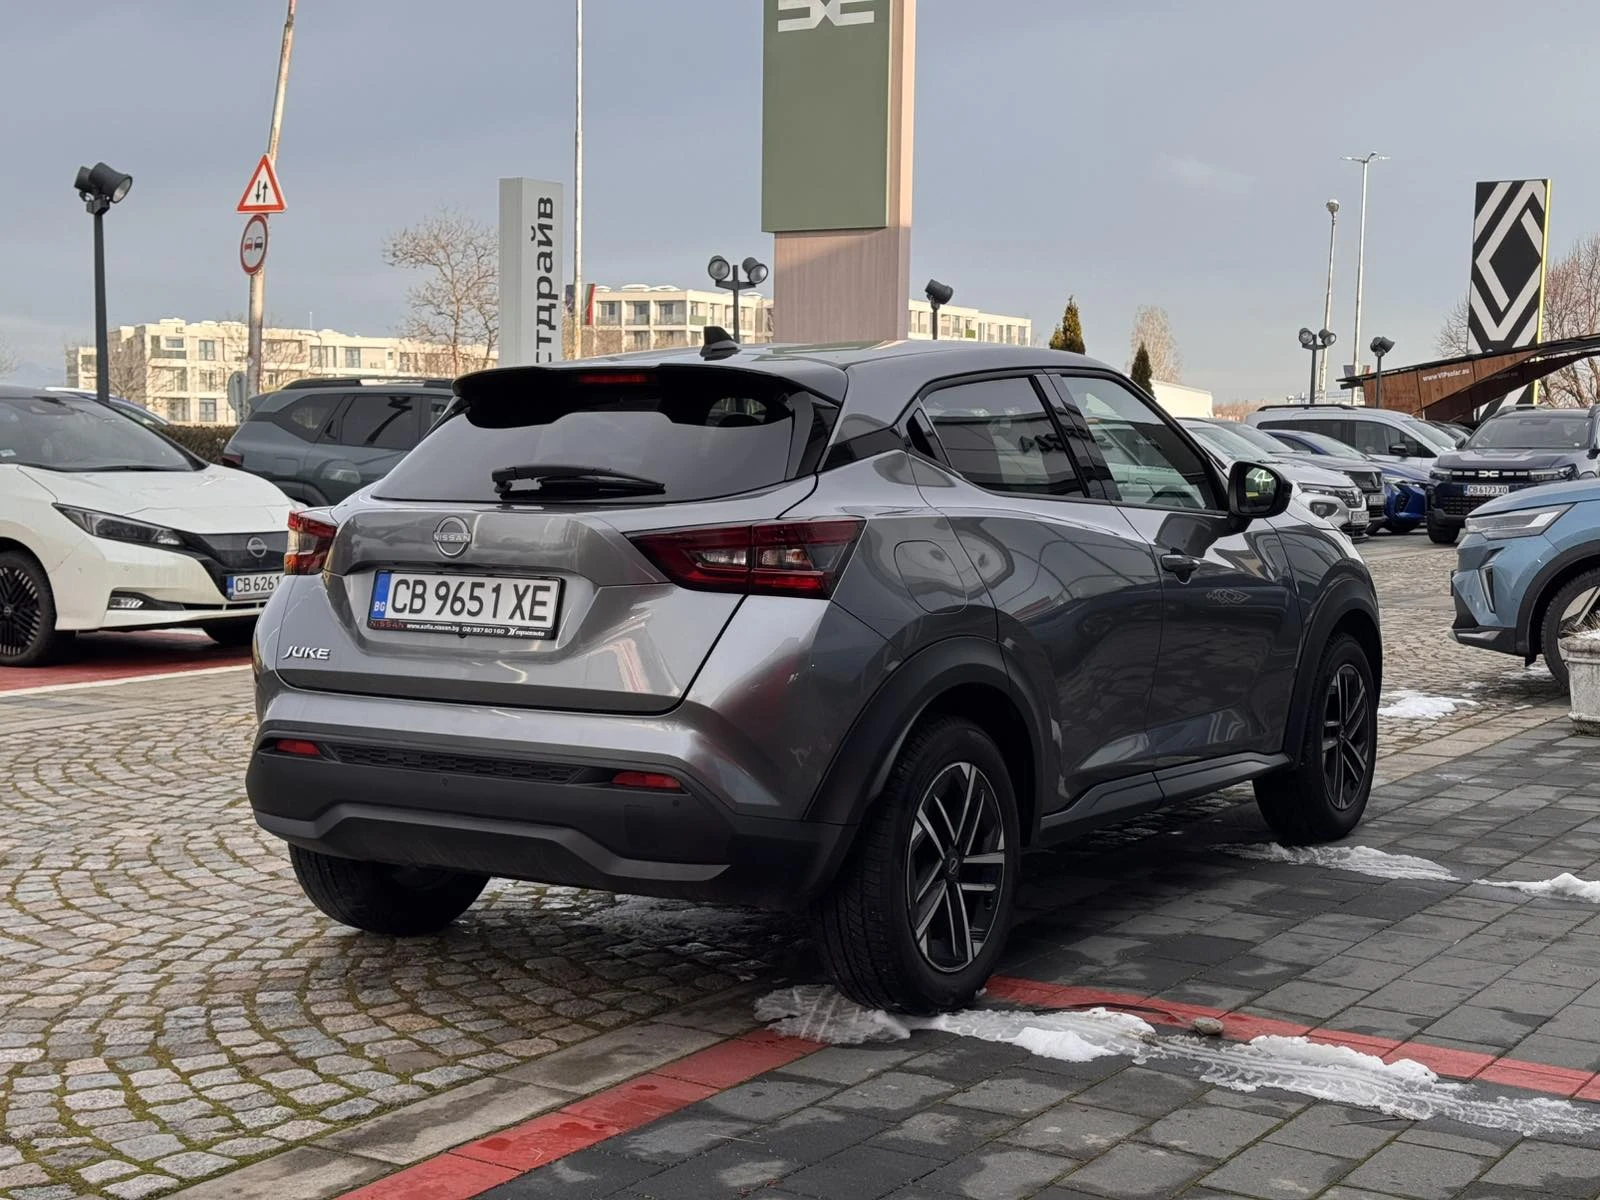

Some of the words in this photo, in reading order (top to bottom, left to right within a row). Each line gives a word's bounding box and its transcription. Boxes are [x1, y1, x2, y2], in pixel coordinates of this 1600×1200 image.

[235, 577, 251, 593] CB
[373, 600, 386, 612] BG
[391, 579, 427, 614] CB
[434, 580, 502, 619] 9651
[508, 583, 551, 622] XE
[281, 645, 331, 660] JUKE
